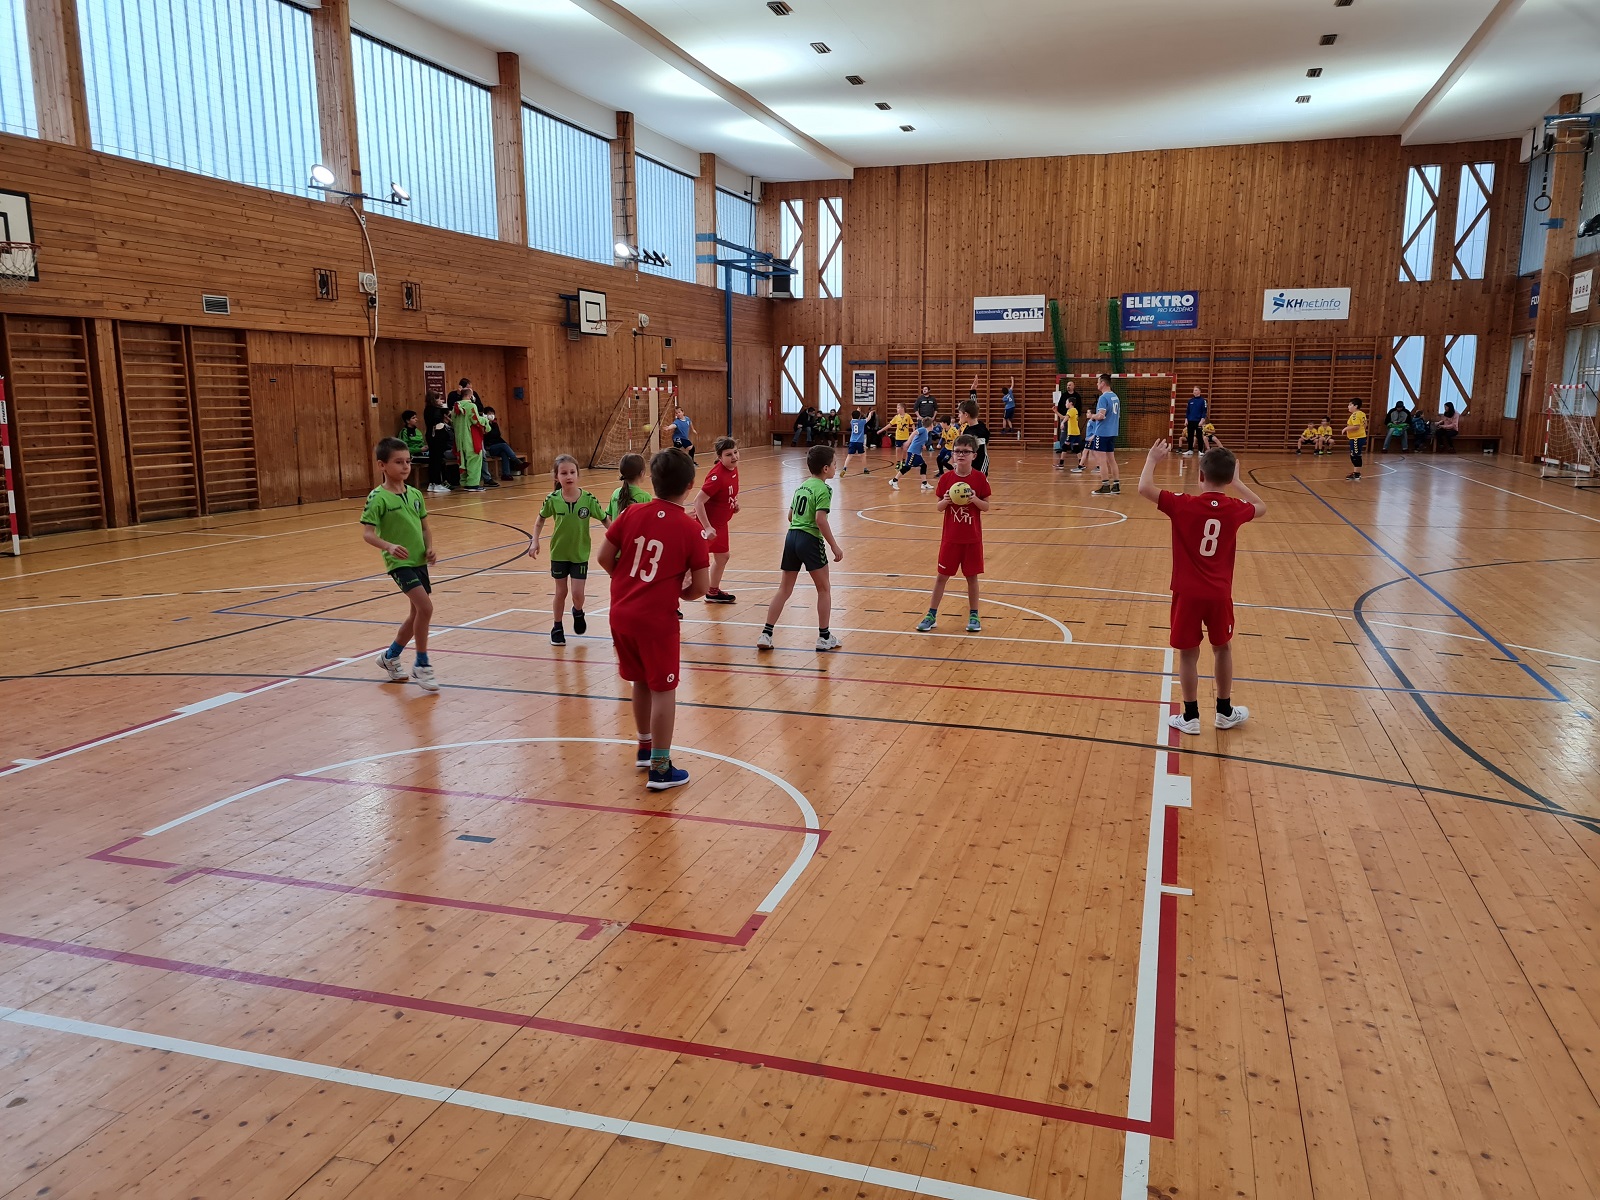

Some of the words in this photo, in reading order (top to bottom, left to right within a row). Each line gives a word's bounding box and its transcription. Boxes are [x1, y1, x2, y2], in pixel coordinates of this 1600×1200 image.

[1126, 294, 1195, 308] ELEKTRO
[1286, 298, 1341, 308] KHnet.info
[1003, 307, 1043, 320] deník
[793, 494, 808, 516] 10
[1199, 518, 1221, 557] 8
[629, 535, 664, 583] 13
